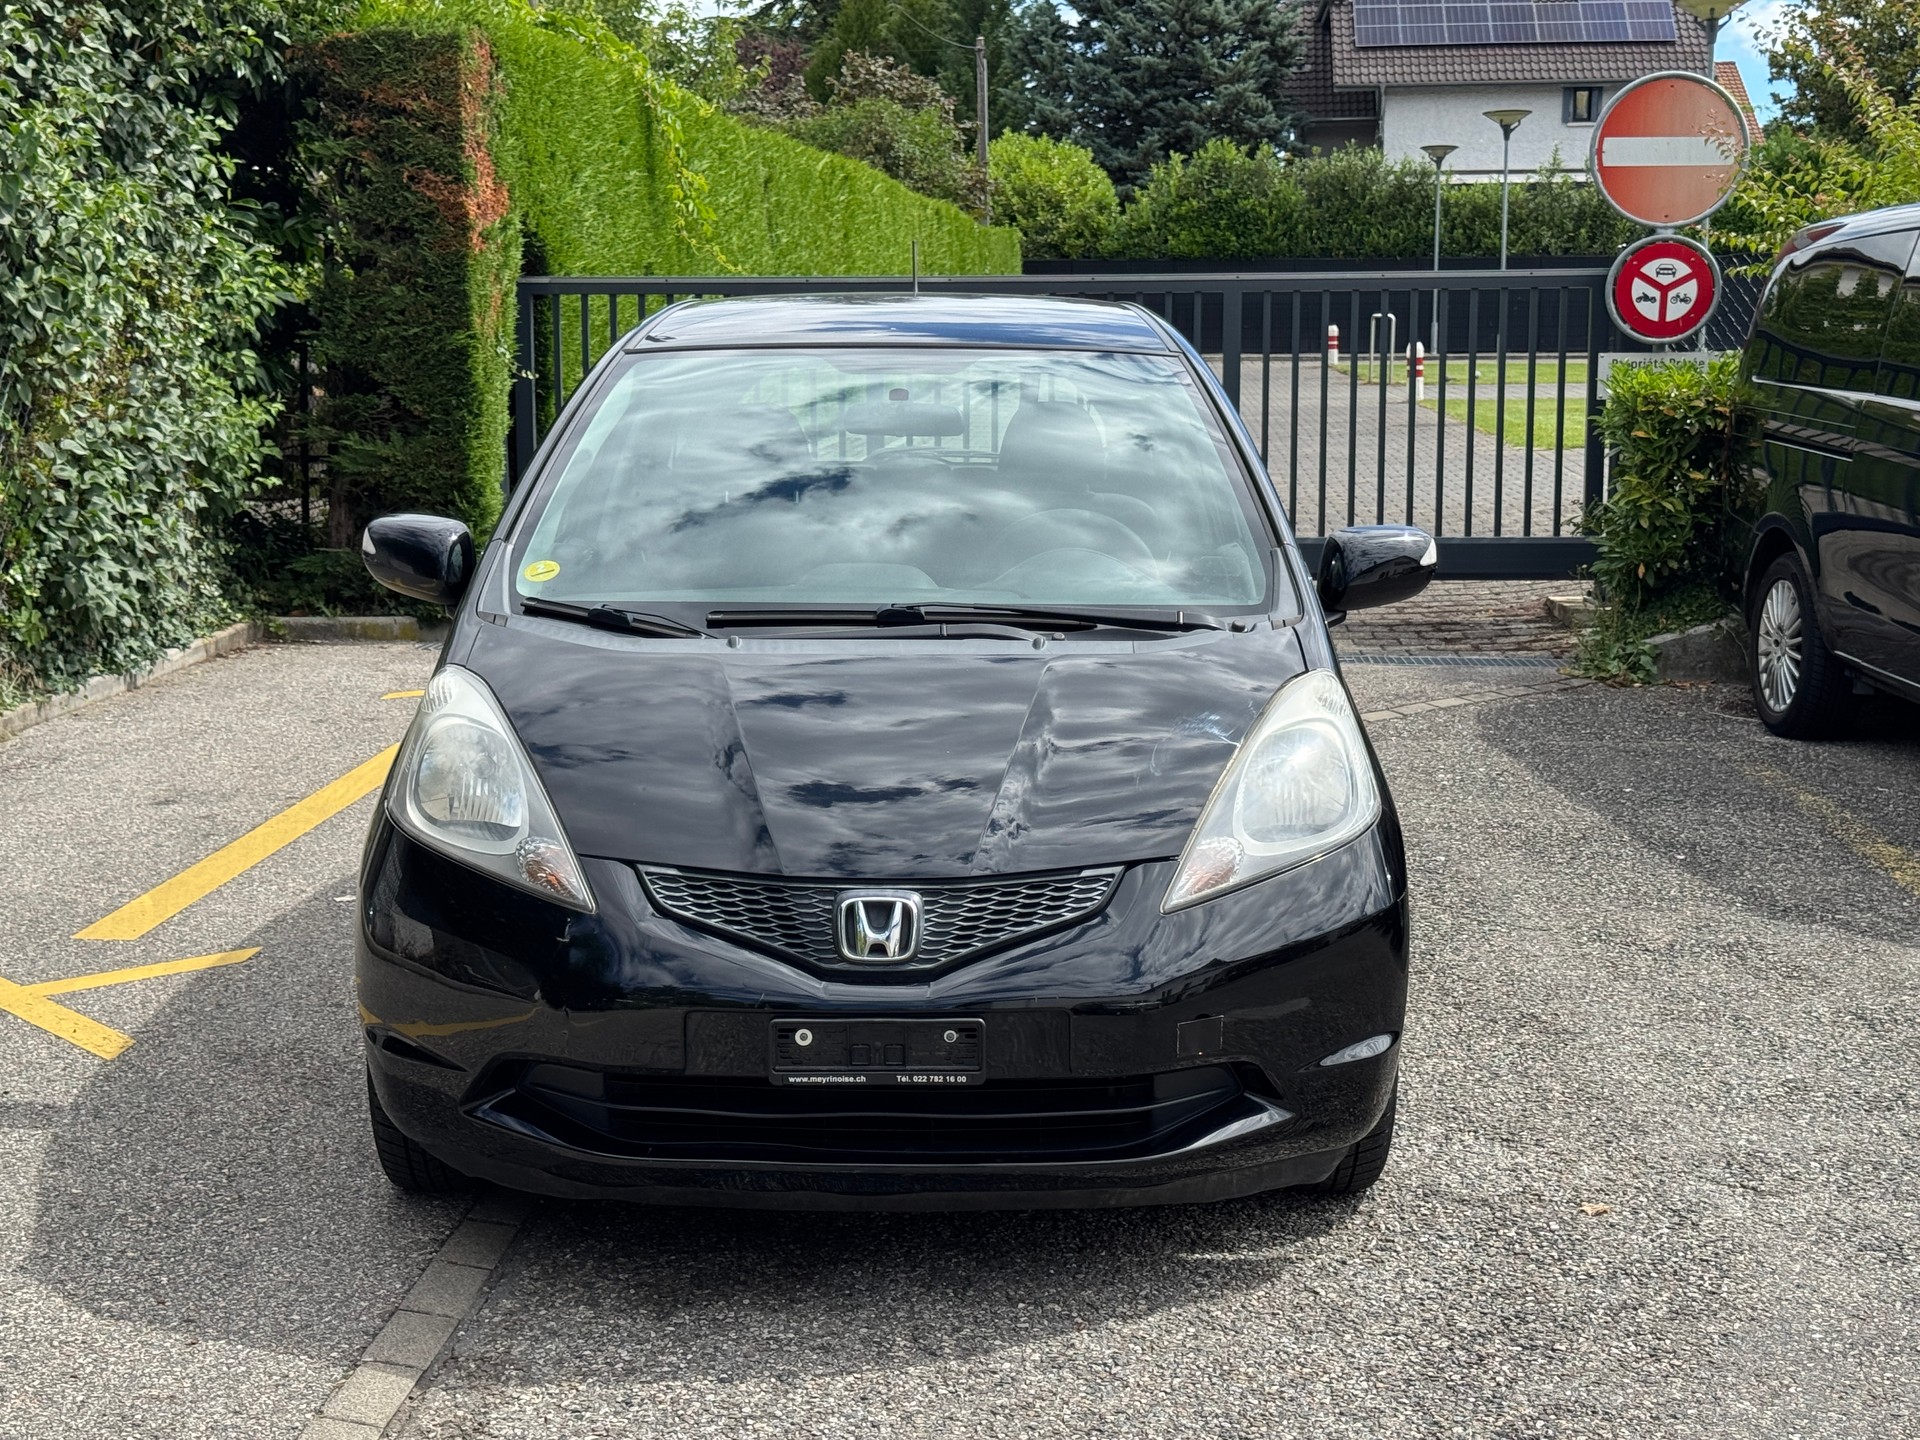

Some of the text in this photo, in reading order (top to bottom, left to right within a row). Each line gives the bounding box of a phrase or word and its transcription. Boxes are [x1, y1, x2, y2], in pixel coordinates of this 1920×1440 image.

[1612, 357, 1664, 370] Ppriété
[788, 1075, 867, 1084] www.meyrinoise.ch
[913, 1075, 928, 1083] 022
[929, 1075, 944, 1083] 782
[946, 1075, 955, 1083] 16
[956, 1075, 967, 1083] 00
